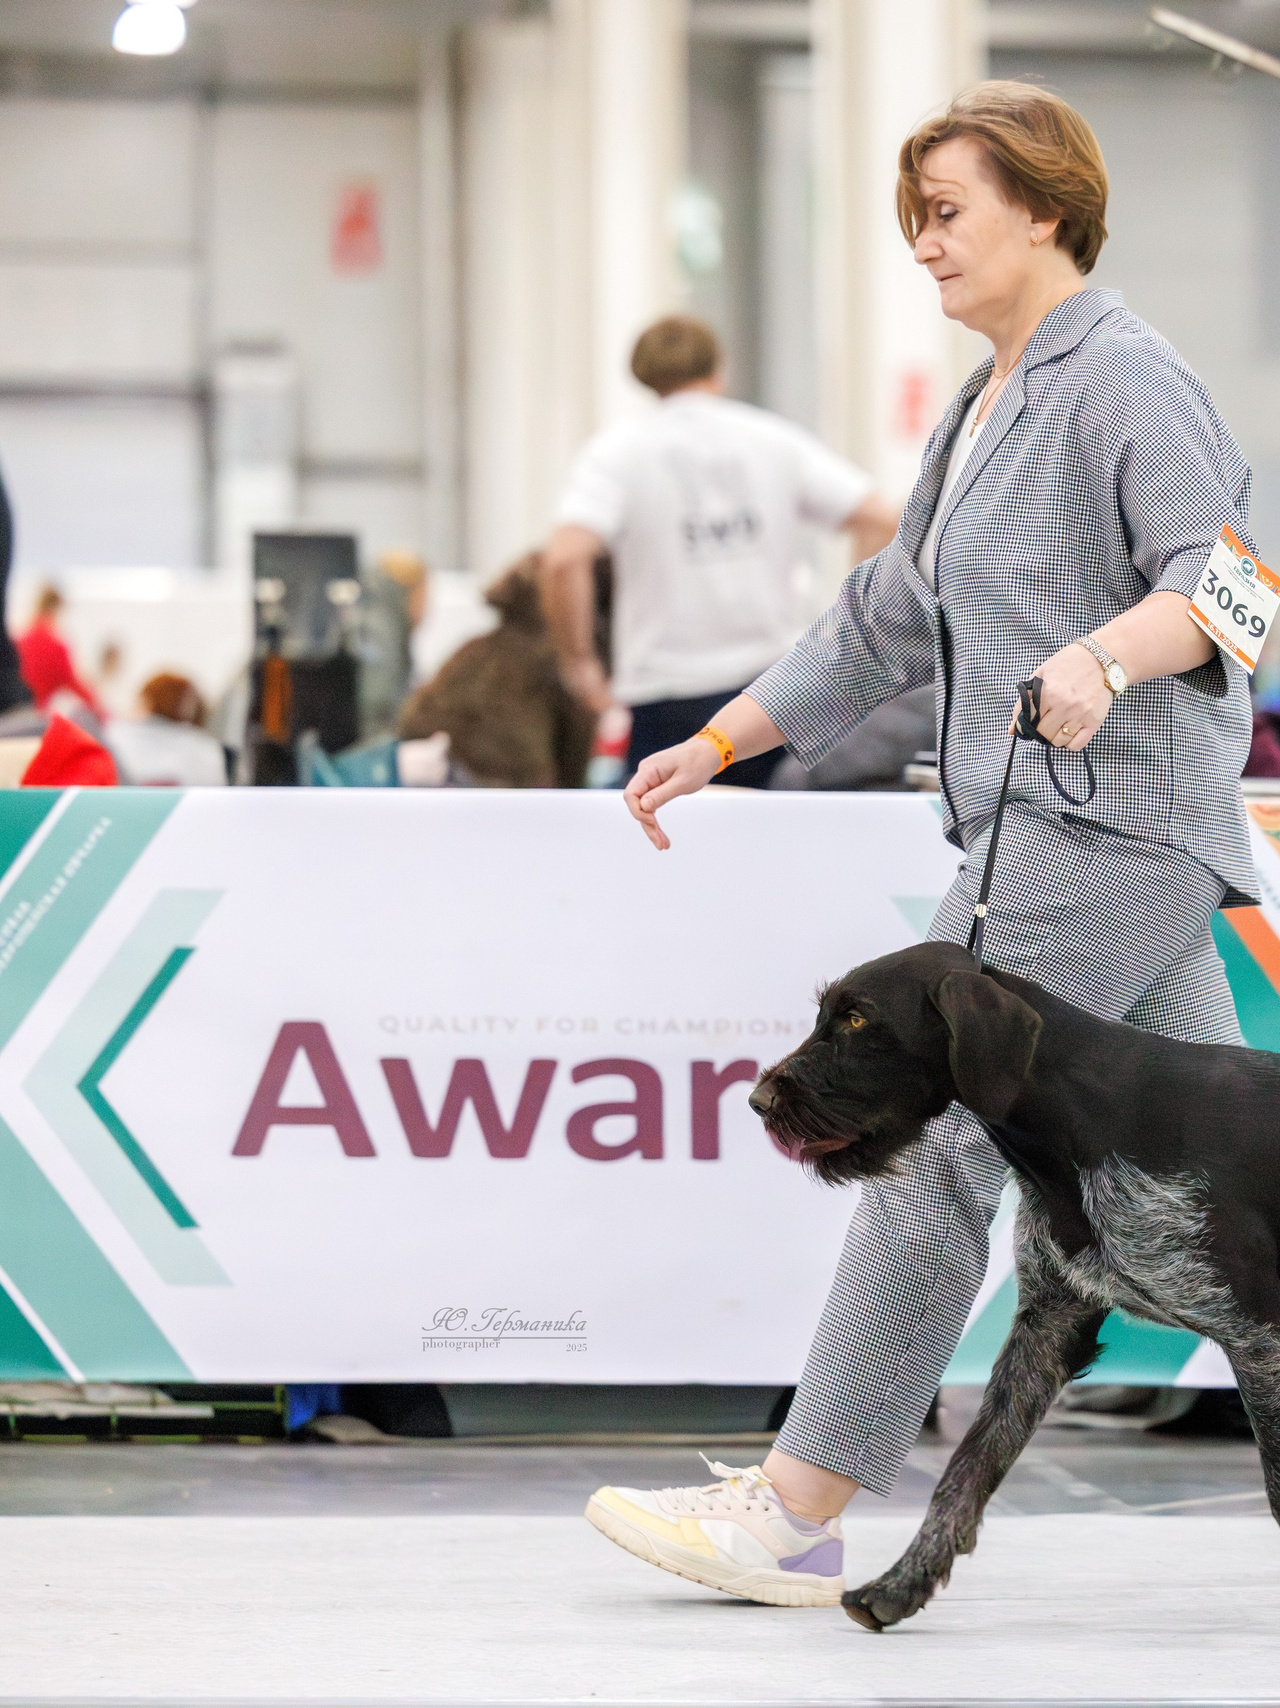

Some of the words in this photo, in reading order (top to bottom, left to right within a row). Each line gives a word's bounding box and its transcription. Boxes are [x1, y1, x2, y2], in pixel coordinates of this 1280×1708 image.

[1202, 568, 1266, 638] 3069
[1206, 620, 1238, 653] 16.11.2025
[378, 1015, 519, 1036] QUALITY
[535, 1016, 599, 1036] FOR
[231, 1021, 806, 1161] Awar
